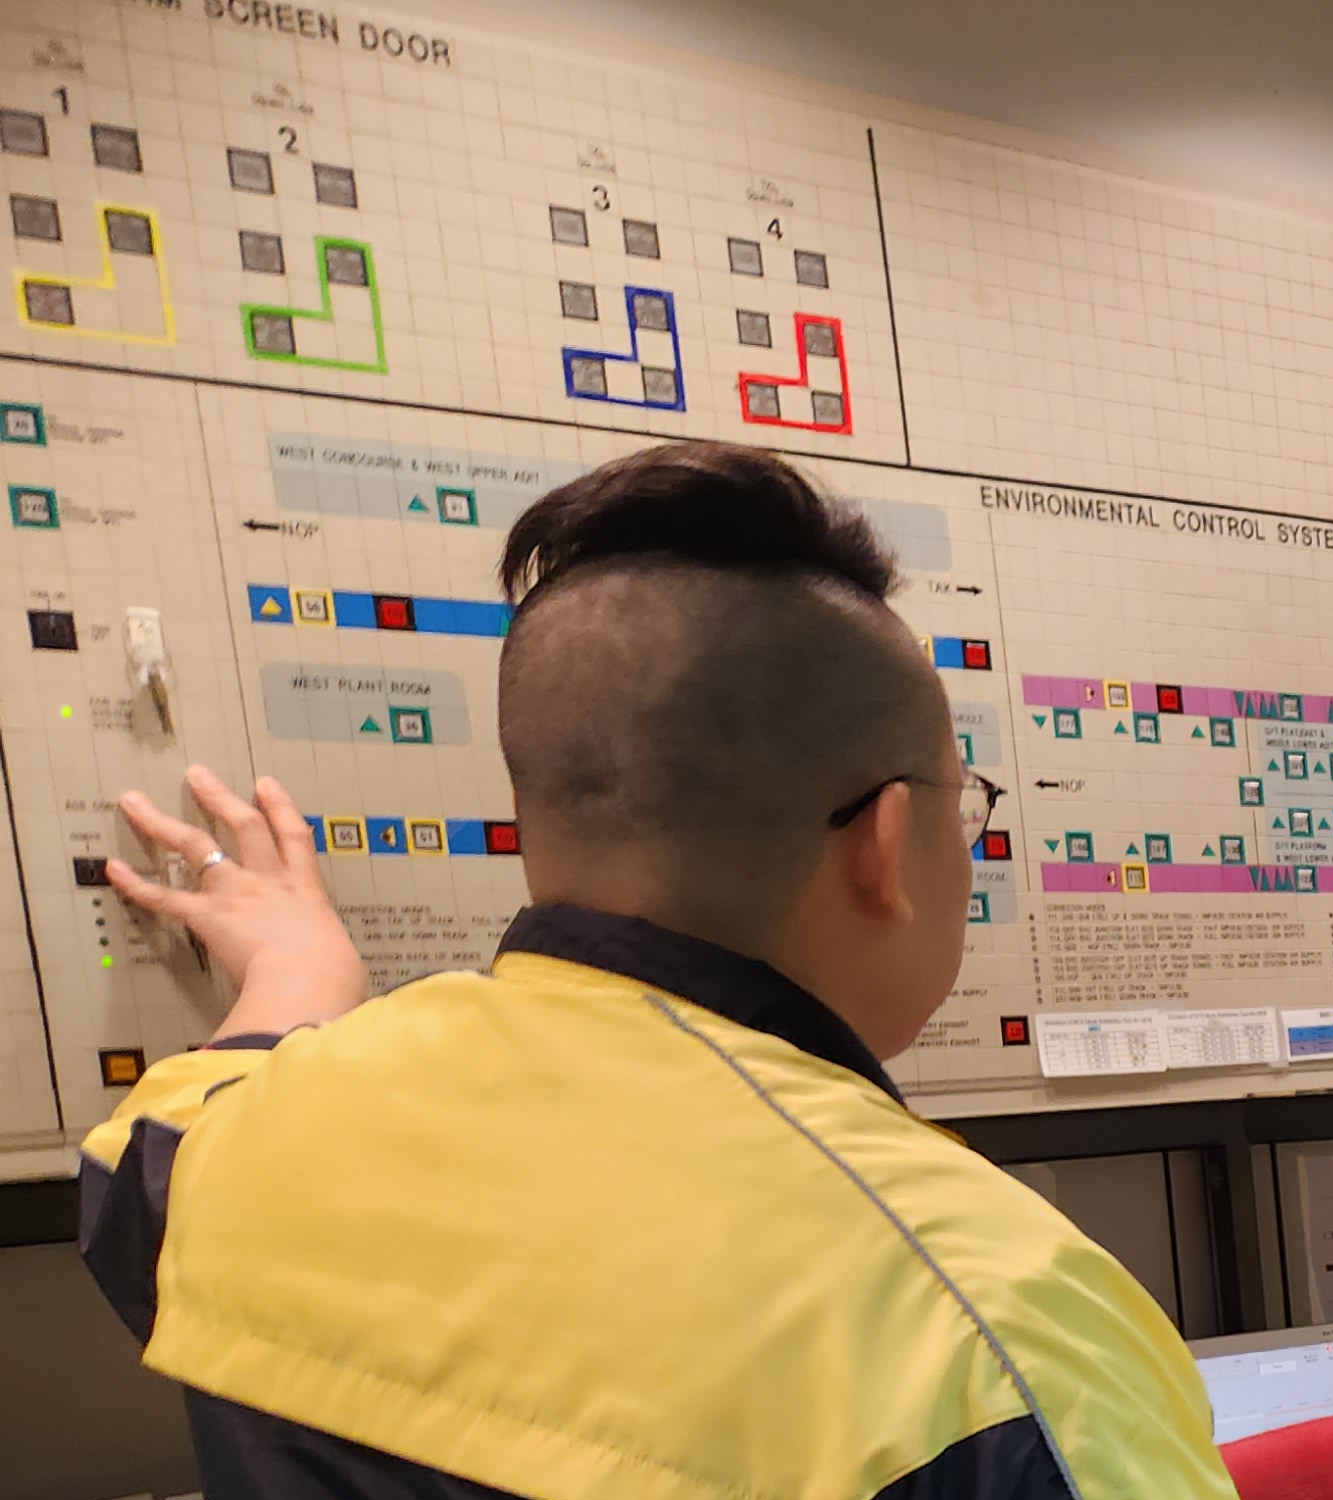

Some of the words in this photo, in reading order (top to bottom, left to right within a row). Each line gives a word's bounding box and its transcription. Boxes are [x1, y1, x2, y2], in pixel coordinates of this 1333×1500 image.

[204, 0, 340, 45] SCREEN
[358, 21, 453, 67] DOOR
[56, 86, 71, 116] 1
[278, 126, 299, 156] 2
[592, 184, 611, 212] 3
[766, 217, 784, 242] 4
[980, 485, 1160, 528] ENVIRONMENTAL
[1173, 510, 1266, 541] CONTROL
[292, 676, 330, 690] WEST
[338, 678, 383, 693] PLANT
[390, 681, 431, 695] ROOM
[1060, 779, 1086, 791] NOP
